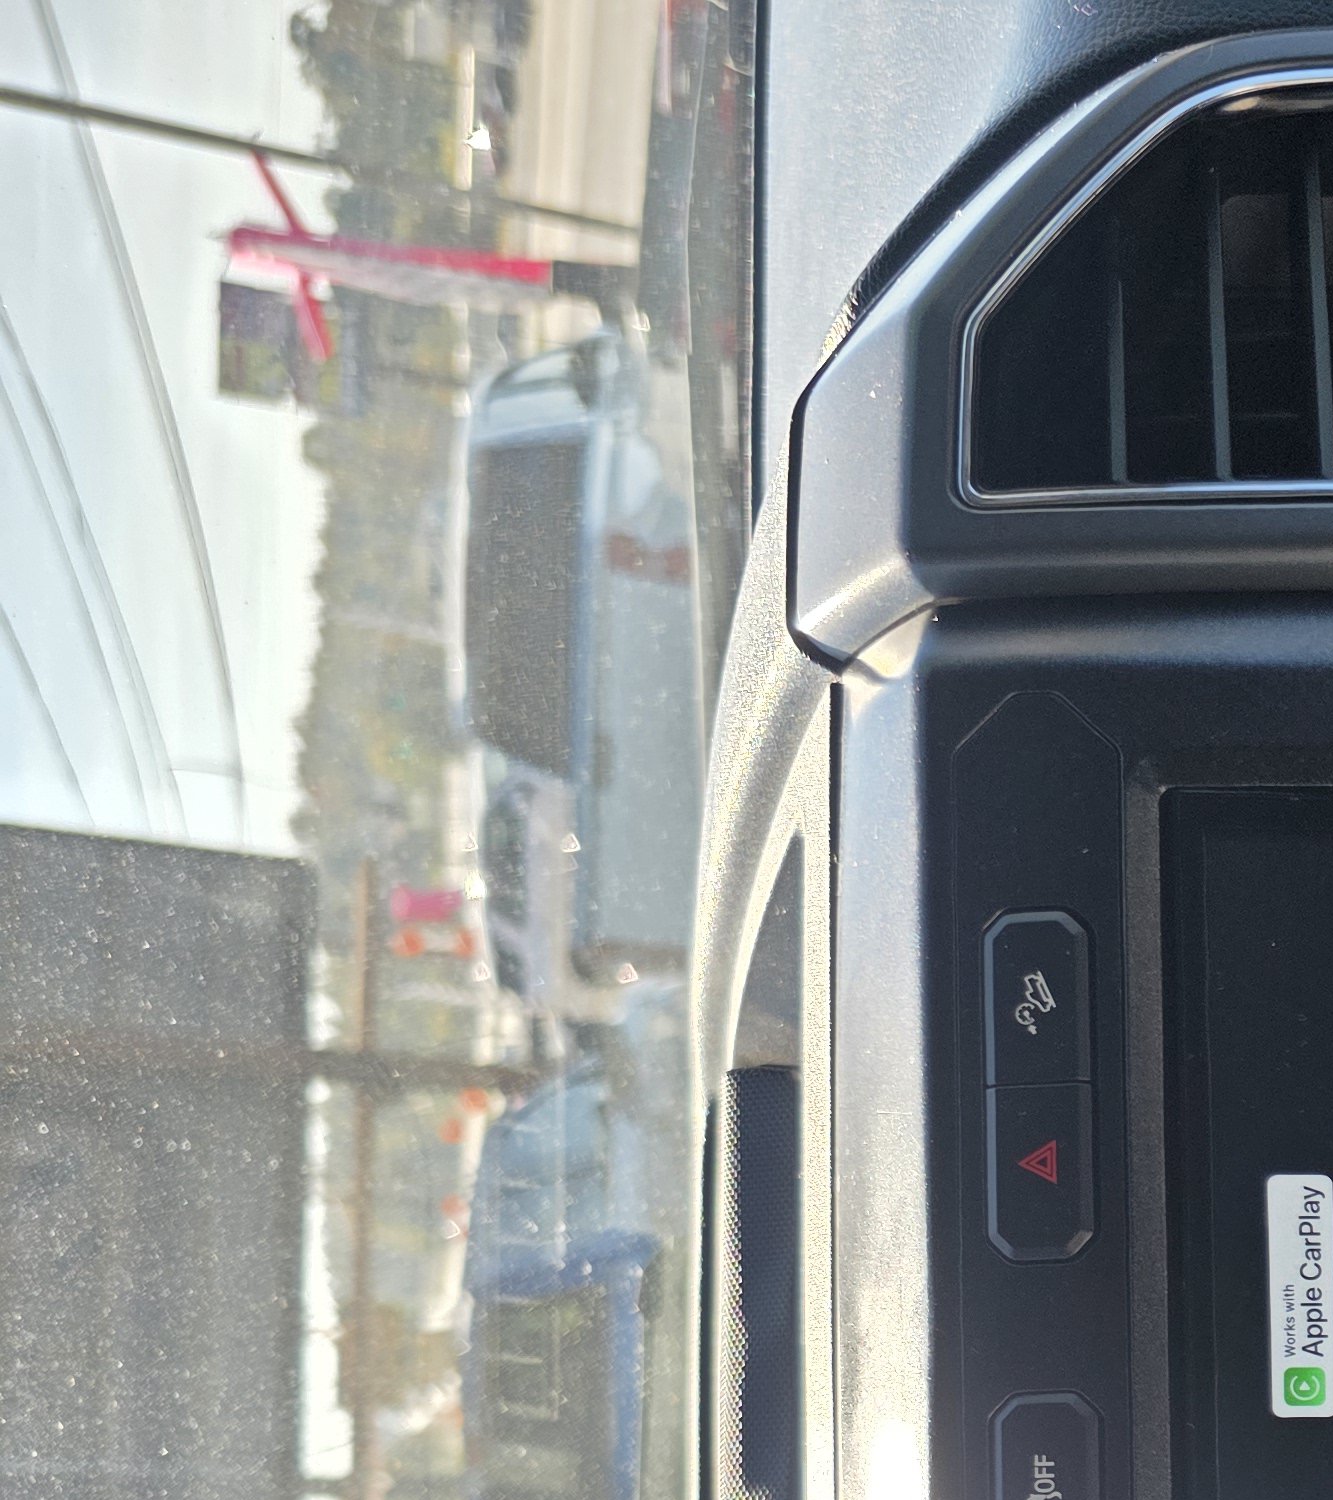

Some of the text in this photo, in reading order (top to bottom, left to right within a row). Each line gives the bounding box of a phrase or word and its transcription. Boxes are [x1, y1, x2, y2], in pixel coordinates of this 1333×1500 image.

[1298, 1186, 1328, 1357] Apple CarPlay
[1283, 1284, 1297, 1358] Works with
[1034, 1454, 1055, 1493] OFF
